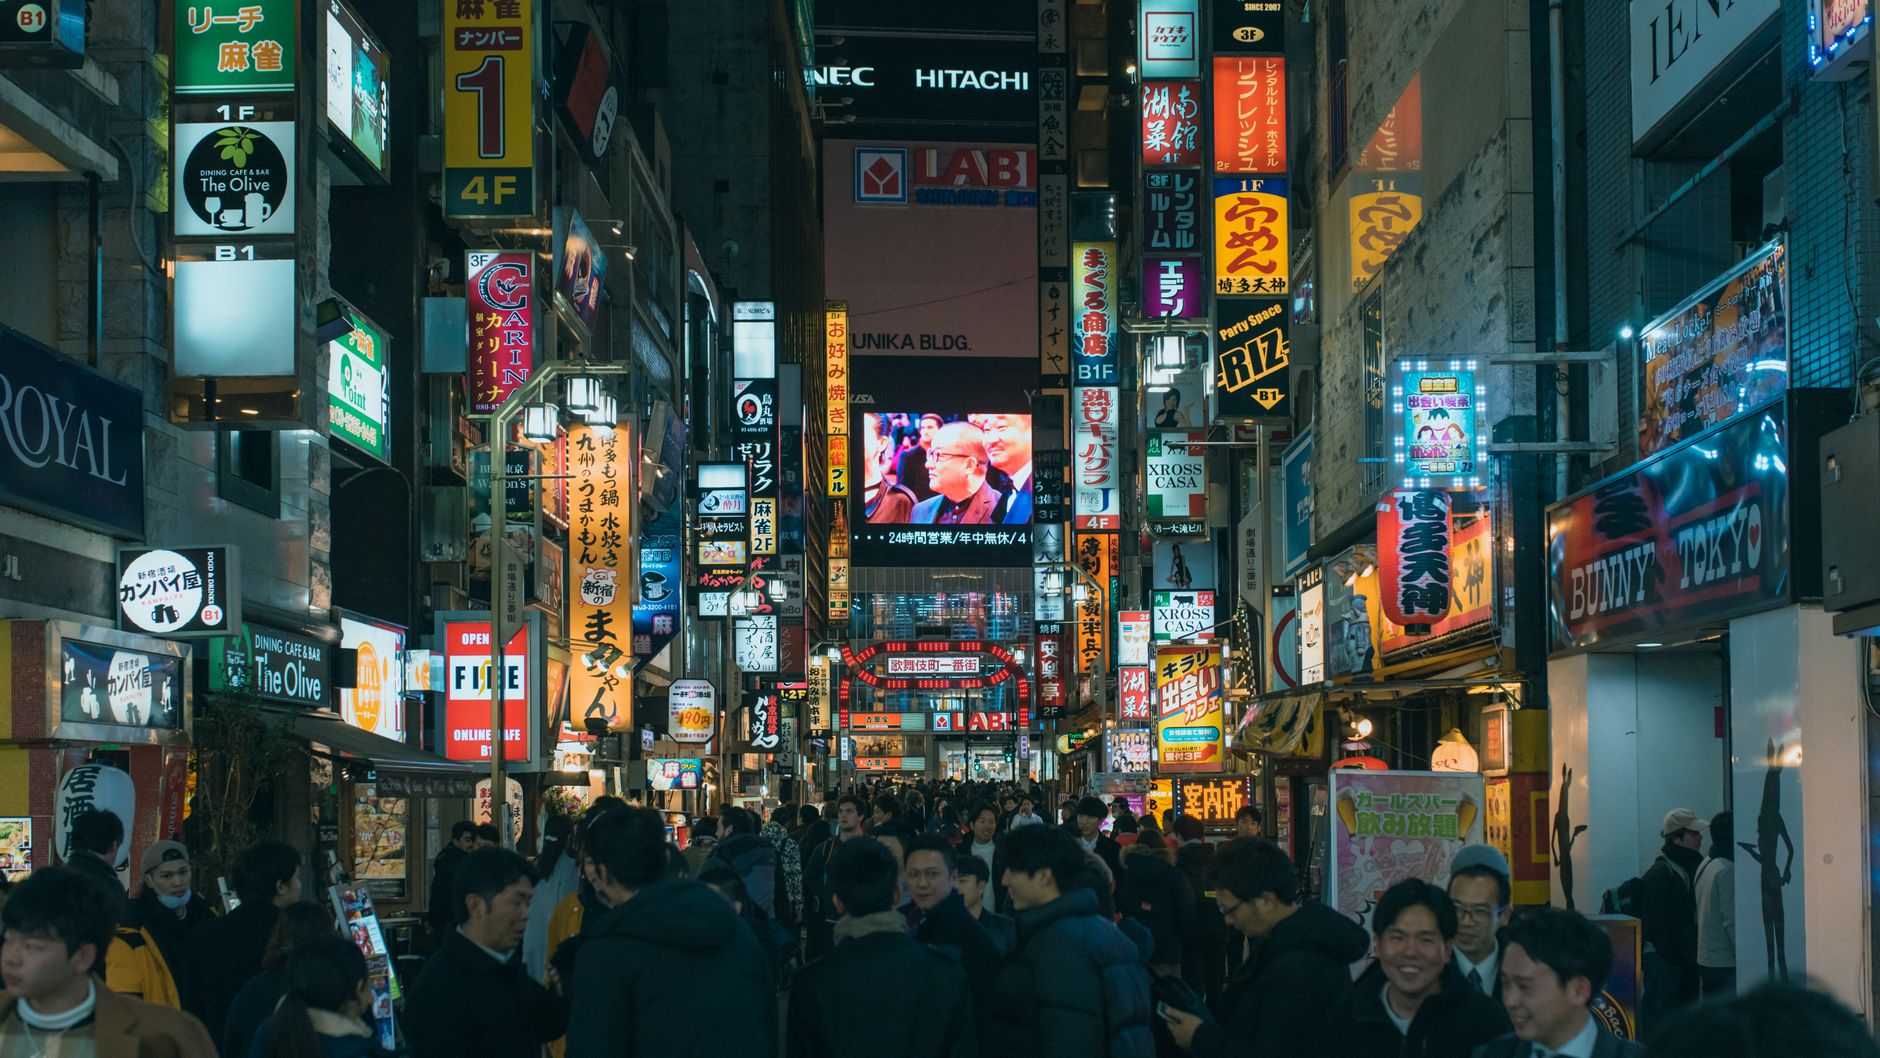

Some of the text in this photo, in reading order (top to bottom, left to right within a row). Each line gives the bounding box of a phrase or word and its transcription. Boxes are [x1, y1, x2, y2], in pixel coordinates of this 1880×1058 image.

[1244, 3, 1281, 11] SINCE 2007
[20, 11, 43, 26] B1
[188, 7, 264, 33] リーチ
[459, 31, 520, 46] ナンバー
[1156, 25, 1187, 34] カブキ
[1240, 29, 1257, 41] 3F
[218, 41, 283, 71] 麻雀
[808, 66, 875, 87] NEC
[915, 69, 1029, 90] HITACHI
[216, 105, 255, 120] 1F
[456, 55, 504, 159] 1
[1143, 85, 1198, 119] 湖南
[1266, 60, 1279, 167] レンタルルーム ホステル
[1042, 115, 1064, 156] 魚金
[1143, 120, 1198, 152] 菜館
[1161, 152, 1182, 164] 4F
[1216, 161, 1230, 171] 2F
[249, 168, 254, 176] &
[255, 168, 270, 176] BAR
[1150, 175, 1169, 187] 3F
[200, 177, 270, 193] The Olive
[461, 176, 517, 205] 4F
[1240, 179, 1264, 192] 1F
[1151, 193, 1171, 248] ルーム
[1175, 174, 1195, 248] レンタル
[215, 246, 255, 261] B1
[470, 255, 488, 267] 3F
[1159, 260, 1185, 317] エデン
[1217, 277, 1287, 294] 博多天神
[1082, 248, 1108, 358] まぐろ商店
[1219, 303, 1283, 342] Party Space
[849, 333, 972, 351] UNIKA BLDG.
[1047, 303, 1063, 373] すずや
[485, 312, 504, 402] カリーナ
[1219, 327, 1287, 393] RIZ
[828, 321, 845, 424] お好み焼き
[1078, 364, 1114, 380] B1F
[1258, 391, 1278, 401] B1
[0, 374, 127, 487] ROYAL
[829, 437, 845, 467] 麻雀
[599, 431, 620, 508] 博多もつ鍋
[753, 442, 773, 493] リラク
[1148, 464, 1203, 476] XROSS
[831, 469, 845, 492] ブル
[1155, 476, 1198, 489] CASA
[576, 433, 598, 565] 九州のうまかもん
[753, 500, 772, 536] 麻雀
[1038, 510, 1059, 519] 3F
[1087, 516, 1109, 529] 4F
[600, 511, 622, 568] 水炊き
[753, 538, 773, 552] 2F
[889, 531, 1033, 545] 24時間営業/年中無休/4
[1678, 503, 1762, 590] TOKYO
[120, 570, 202, 603] カンパイ屋
[582, 581, 613, 598] 新宿
[204, 610, 220, 621] B1
[1158, 608, 1210, 620] XROSS
[1040, 624, 1060, 634] 焼肉
[1164, 620, 1206, 632] CASA
[255, 633, 321, 662] DINING CAFE & BAR
[462, 633, 489, 645] OPEN
[760, 616, 776, 659] 居酒屋
[890, 659, 978, 672] 歌舞伎町一番街
[1040, 639, 1060, 701] 安楽亭
[1162, 649, 1210, 679] キラリ
[107, 667, 152, 697] カンパイ屋
[255, 656, 321, 700] The Olive
[1161, 667, 1217, 714] 出会い
[679, 711, 711, 726] 190円
[1043, 707, 1059, 716] 2F
[1184, 694, 1221, 725] カフェ
[454, 729, 492, 741] ONLINE
[1165, 752, 1203, 762] 受付3F
[1184, 781, 1243, 820] 案内所
[1356, 792, 1457, 809] ガールズバー
[1356, 811, 1459, 839] 飲み放題
